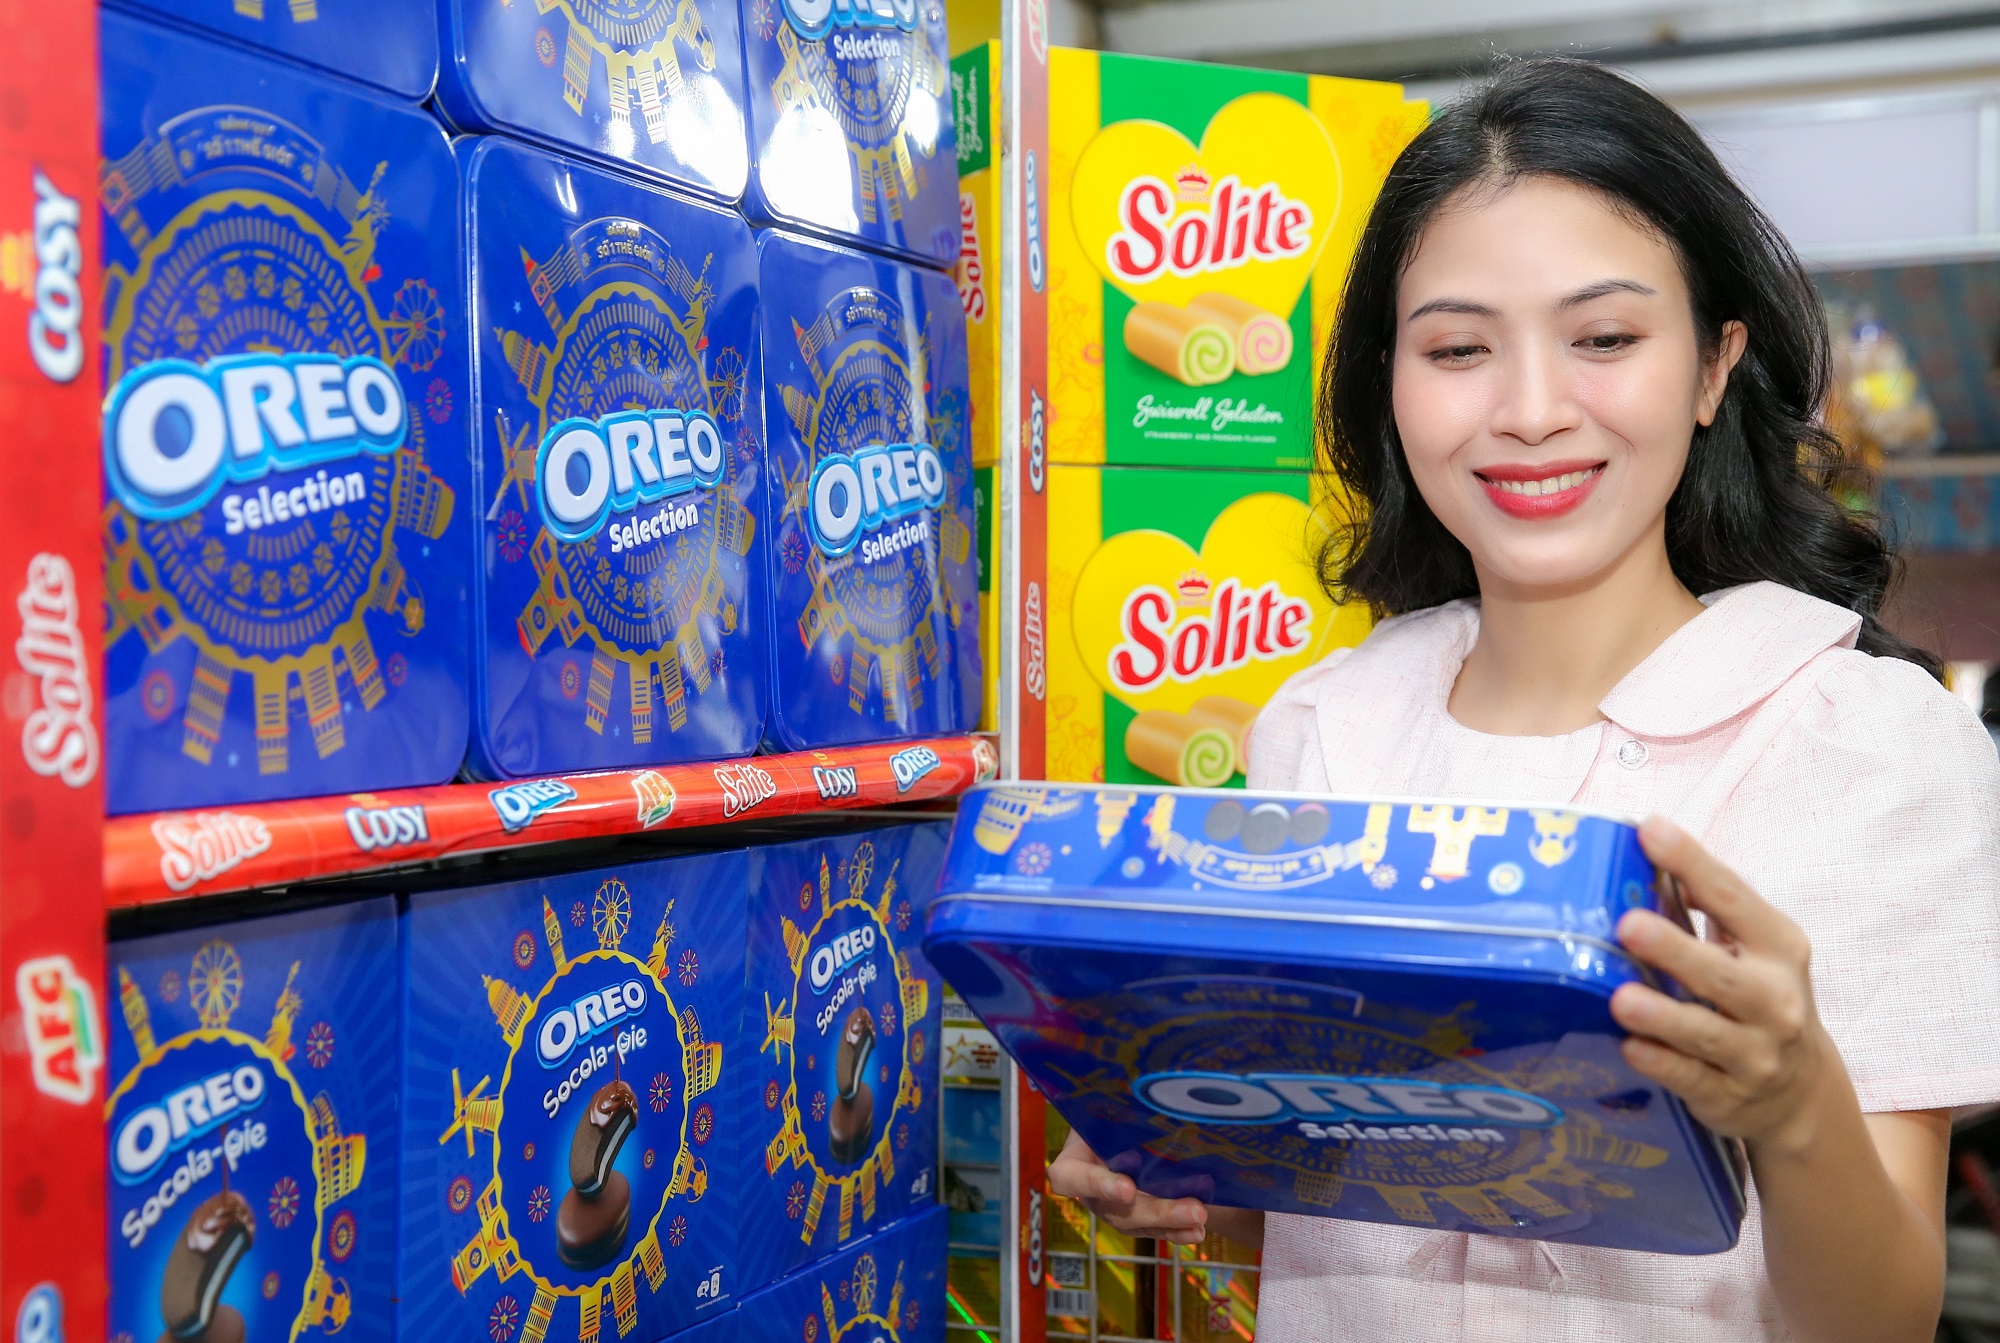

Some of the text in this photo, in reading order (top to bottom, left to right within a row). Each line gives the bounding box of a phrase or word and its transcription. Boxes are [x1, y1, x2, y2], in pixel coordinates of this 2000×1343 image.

[834, 33, 900, 60] Selection
[1027, 150, 1043, 290] OREO
[1108, 178, 1312, 282] Solite
[30, 163, 83, 383] COSY
[112, 360, 404, 502] OREO
[540, 413, 725, 535] OREO
[1030, 384, 1044, 494] COSY
[222, 470, 366, 535] Selection
[609, 502, 699, 554] Selection
[810, 447, 945, 552] OREO
[862, 518, 928, 564] Selection
[18, 553, 98, 787] Solite
[1025, 581, 1045, 701] Solite
[1109, 584, 1311, 692] Solite
[151, 811, 272, 890] Solite
[346, 805, 430, 851] COSY
[491, 782, 577, 829] OREO
[632, 771, 676, 822] AFC
[714, 764, 777, 818] Solite
[813, 767, 857, 799] COSY
[891, 748, 940, 791] OREO
[813, 924, 875, 991] OREO
[815, 960, 878, 1036] Socola-pie
[18, 957, 100, 1104] AFC
[538, 980, 646, 1066] OREO
[543, 1026, 648, 1119] Socola-pie
[113, 1065, 266, 1183] OREO
[1142, 1074, 1556, 1127] OREO
[1299, 1122, 1505, 1145] Selection
[120, 1119, 268, 1248] Socola-pie
[1028, 1187, 1043, 1287] COSY
